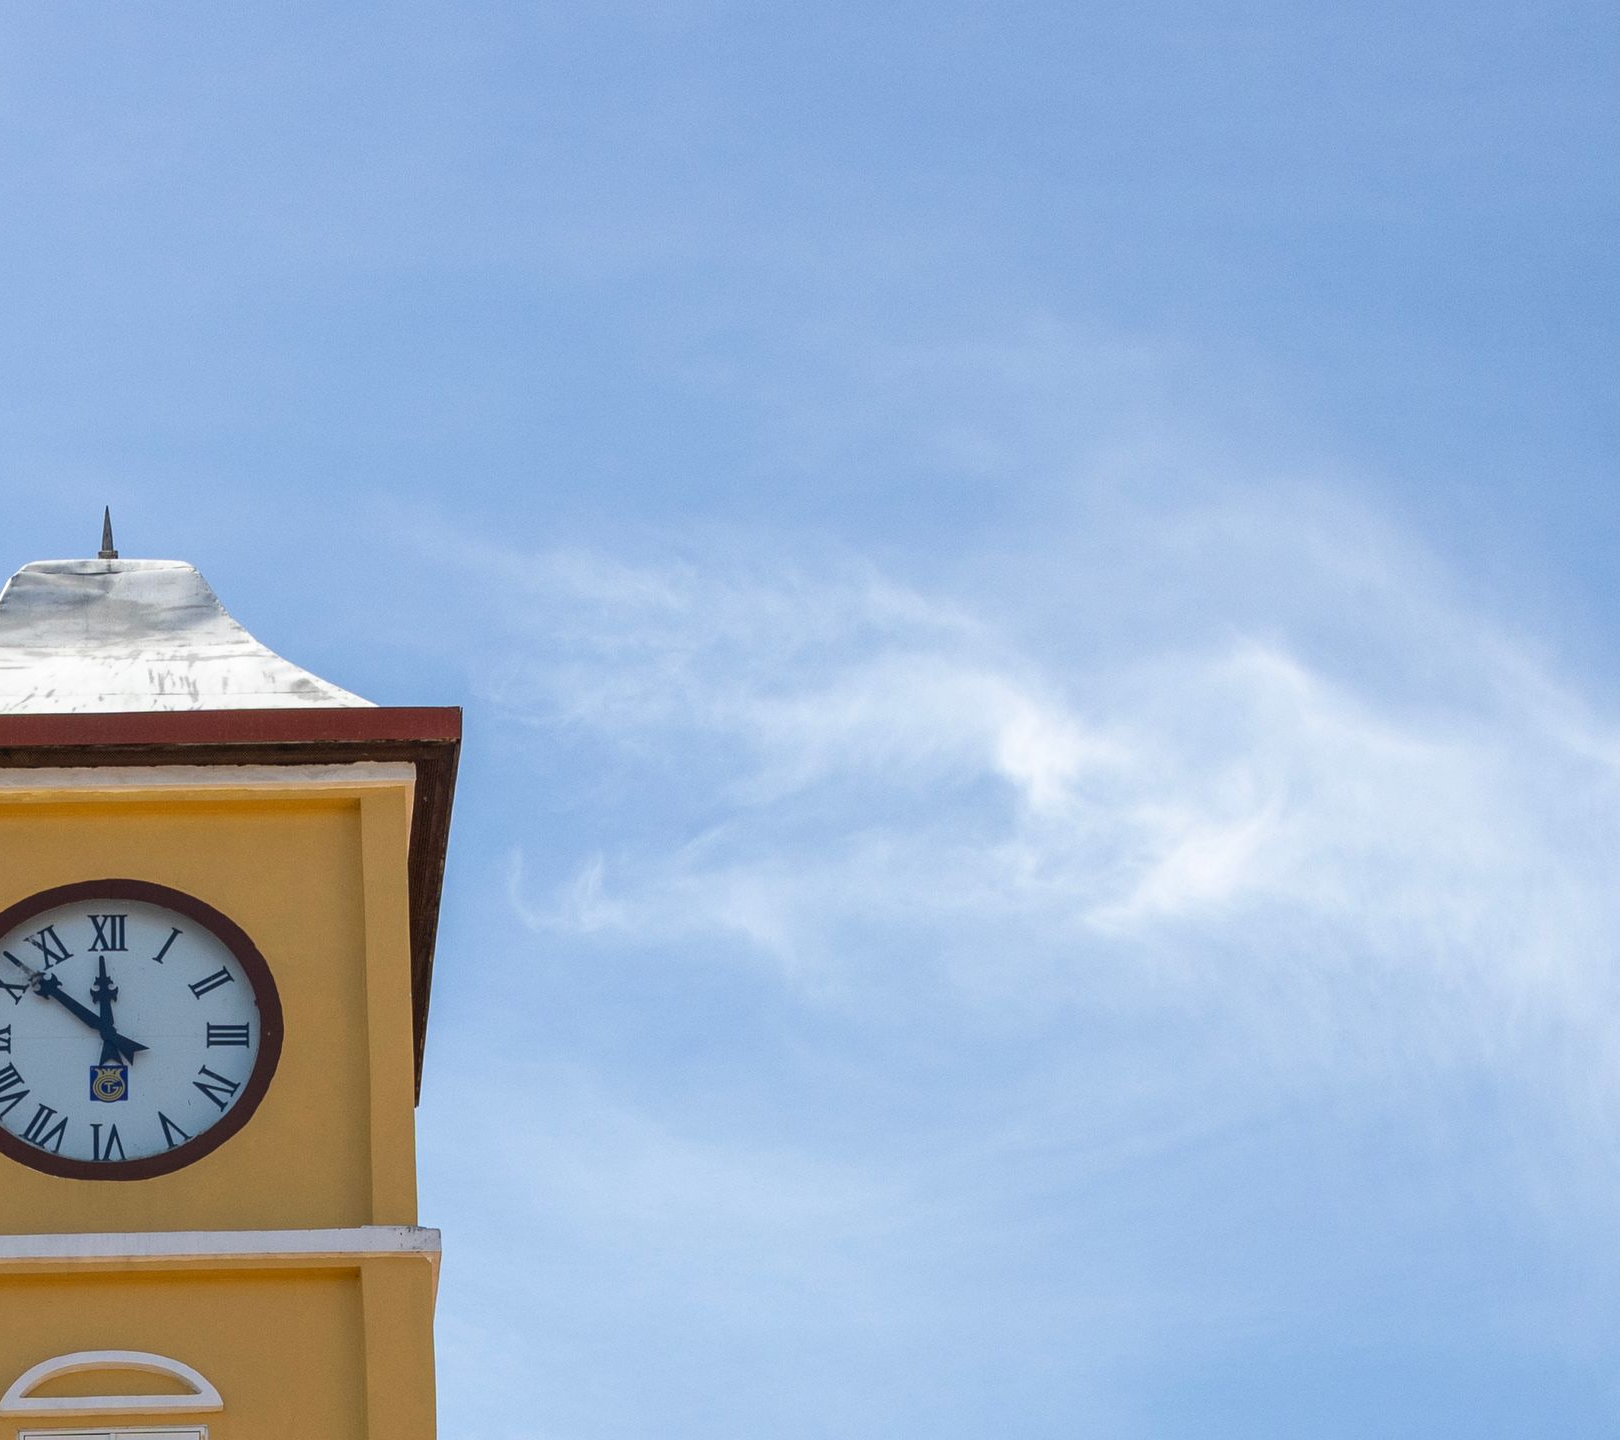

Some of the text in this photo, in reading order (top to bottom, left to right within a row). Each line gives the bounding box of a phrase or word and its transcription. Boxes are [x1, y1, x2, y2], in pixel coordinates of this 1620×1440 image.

[25, 925, 74, 970] XI
[87, 914, 129, 952] XII
[188, 966, 235, 1000] II
[206, 1022, 250, 1049] III
